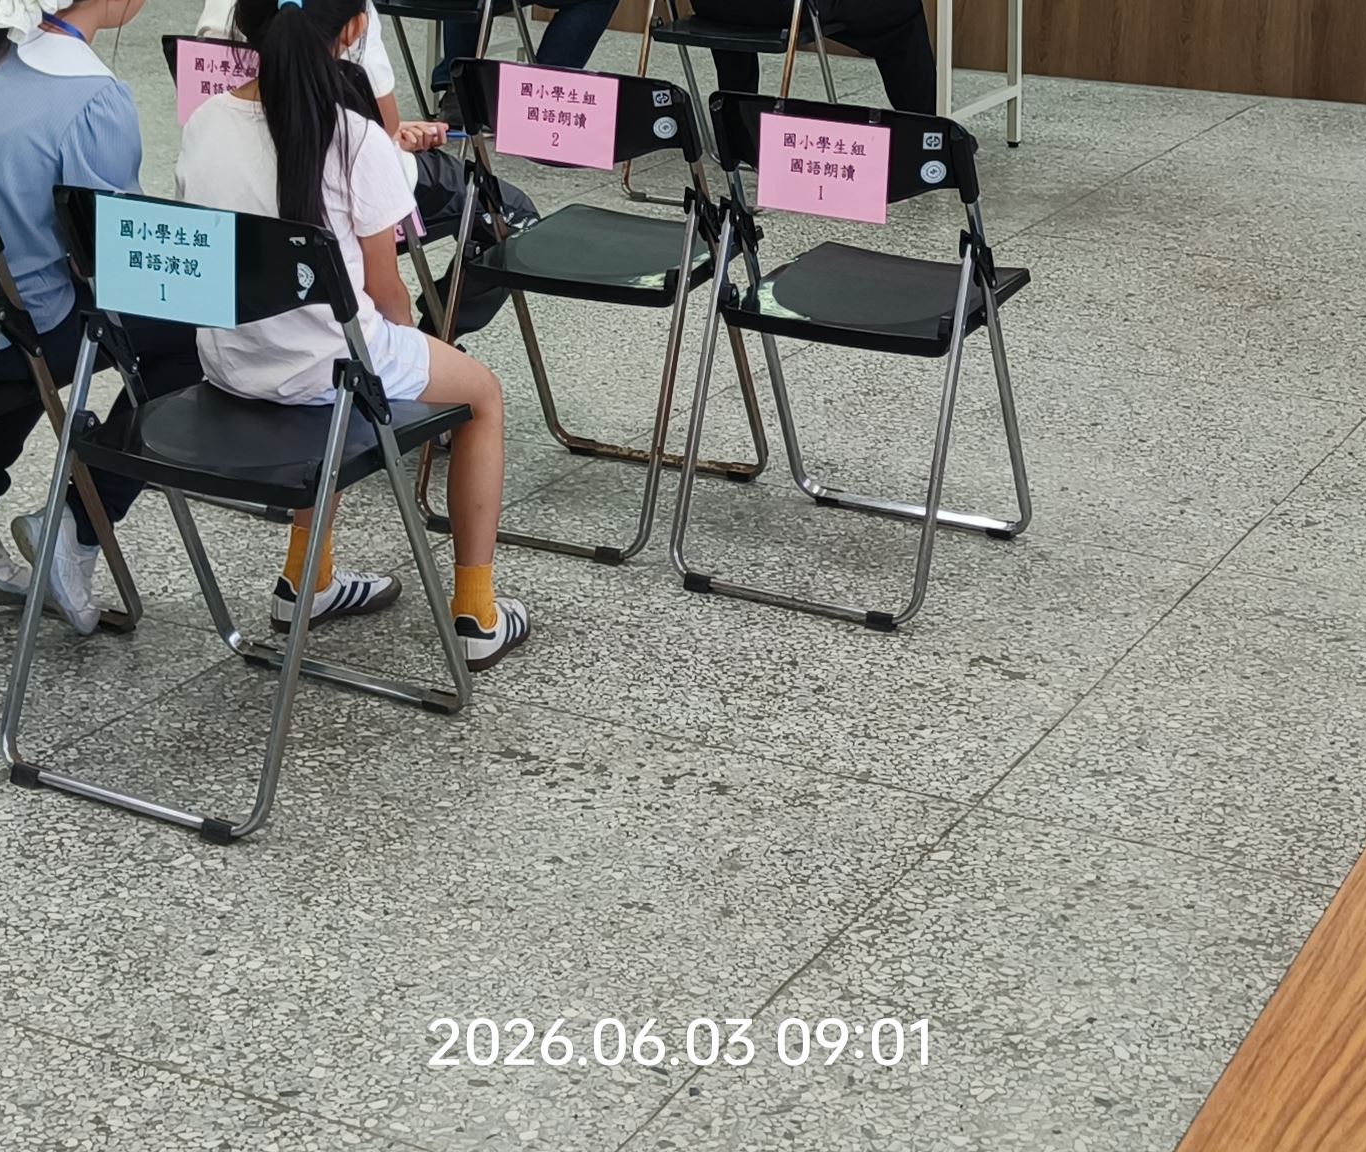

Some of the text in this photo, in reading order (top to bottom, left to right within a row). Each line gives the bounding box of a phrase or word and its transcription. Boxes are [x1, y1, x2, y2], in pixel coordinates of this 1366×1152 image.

[521, 82, 597, 106] 國小學生組
[527, 107, 587, 129] 國語朗讀
[551, 132, 560, 147] 2
[784, 133, 866, 156] 國小學生組
[791, 158, 855, 181] 國語朗讀
[817, 185, 824, 200] 1
[120, 219, 211, 248] 國小學生組
[129, 250, 201, 278] 國語演說
[160, 283, 167, 301] 1
